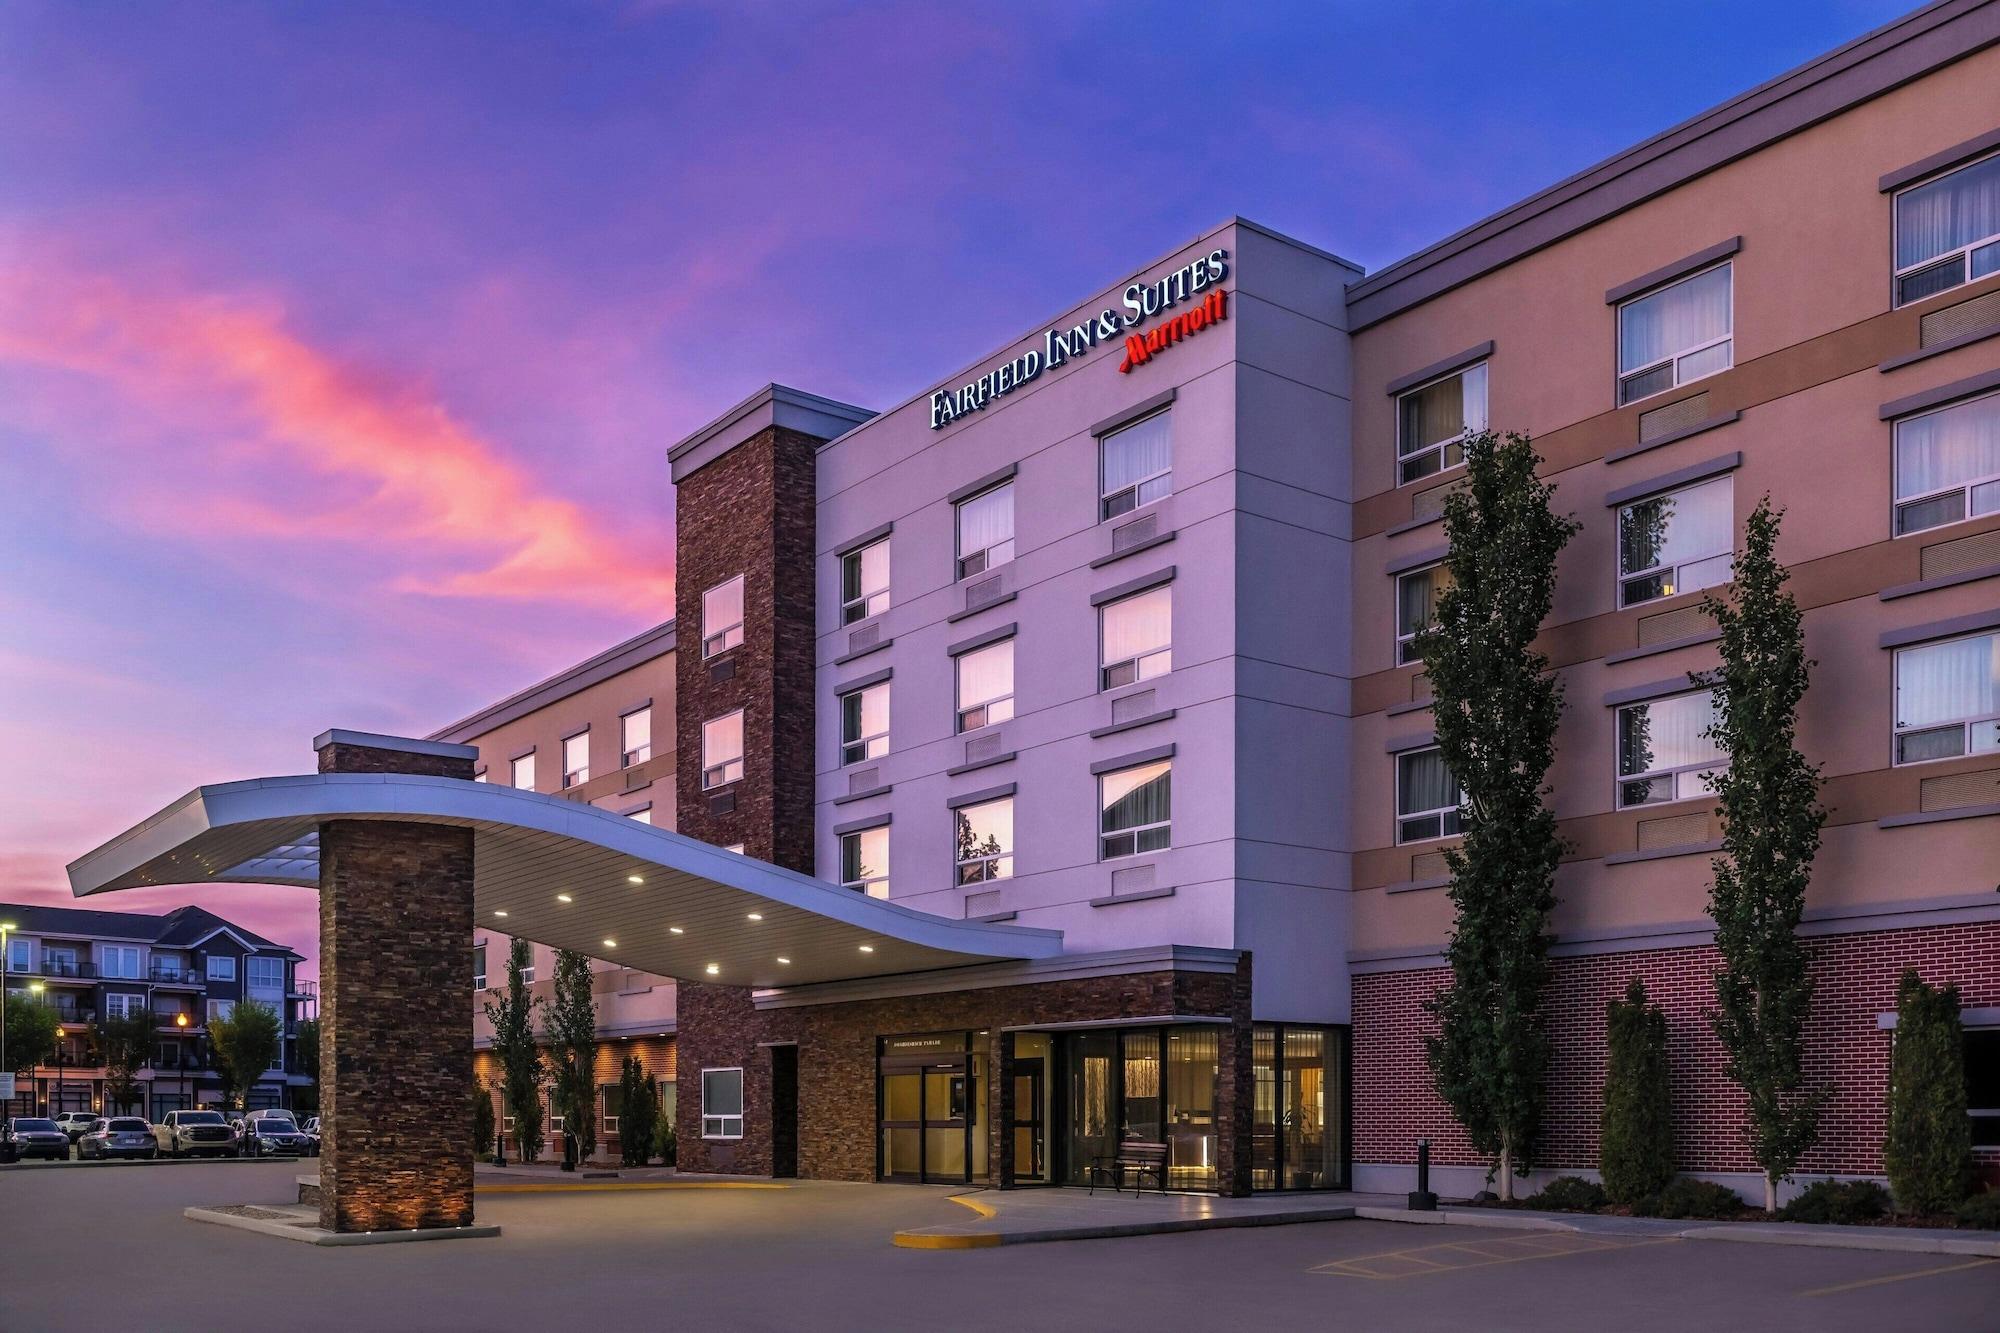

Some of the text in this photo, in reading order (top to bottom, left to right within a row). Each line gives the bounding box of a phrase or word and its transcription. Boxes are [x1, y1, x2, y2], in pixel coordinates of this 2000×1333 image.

[930, 249, 1229, 430] FAIRFIELD INN & SUITES
[1119, 288, 1228, 374] Marriott
